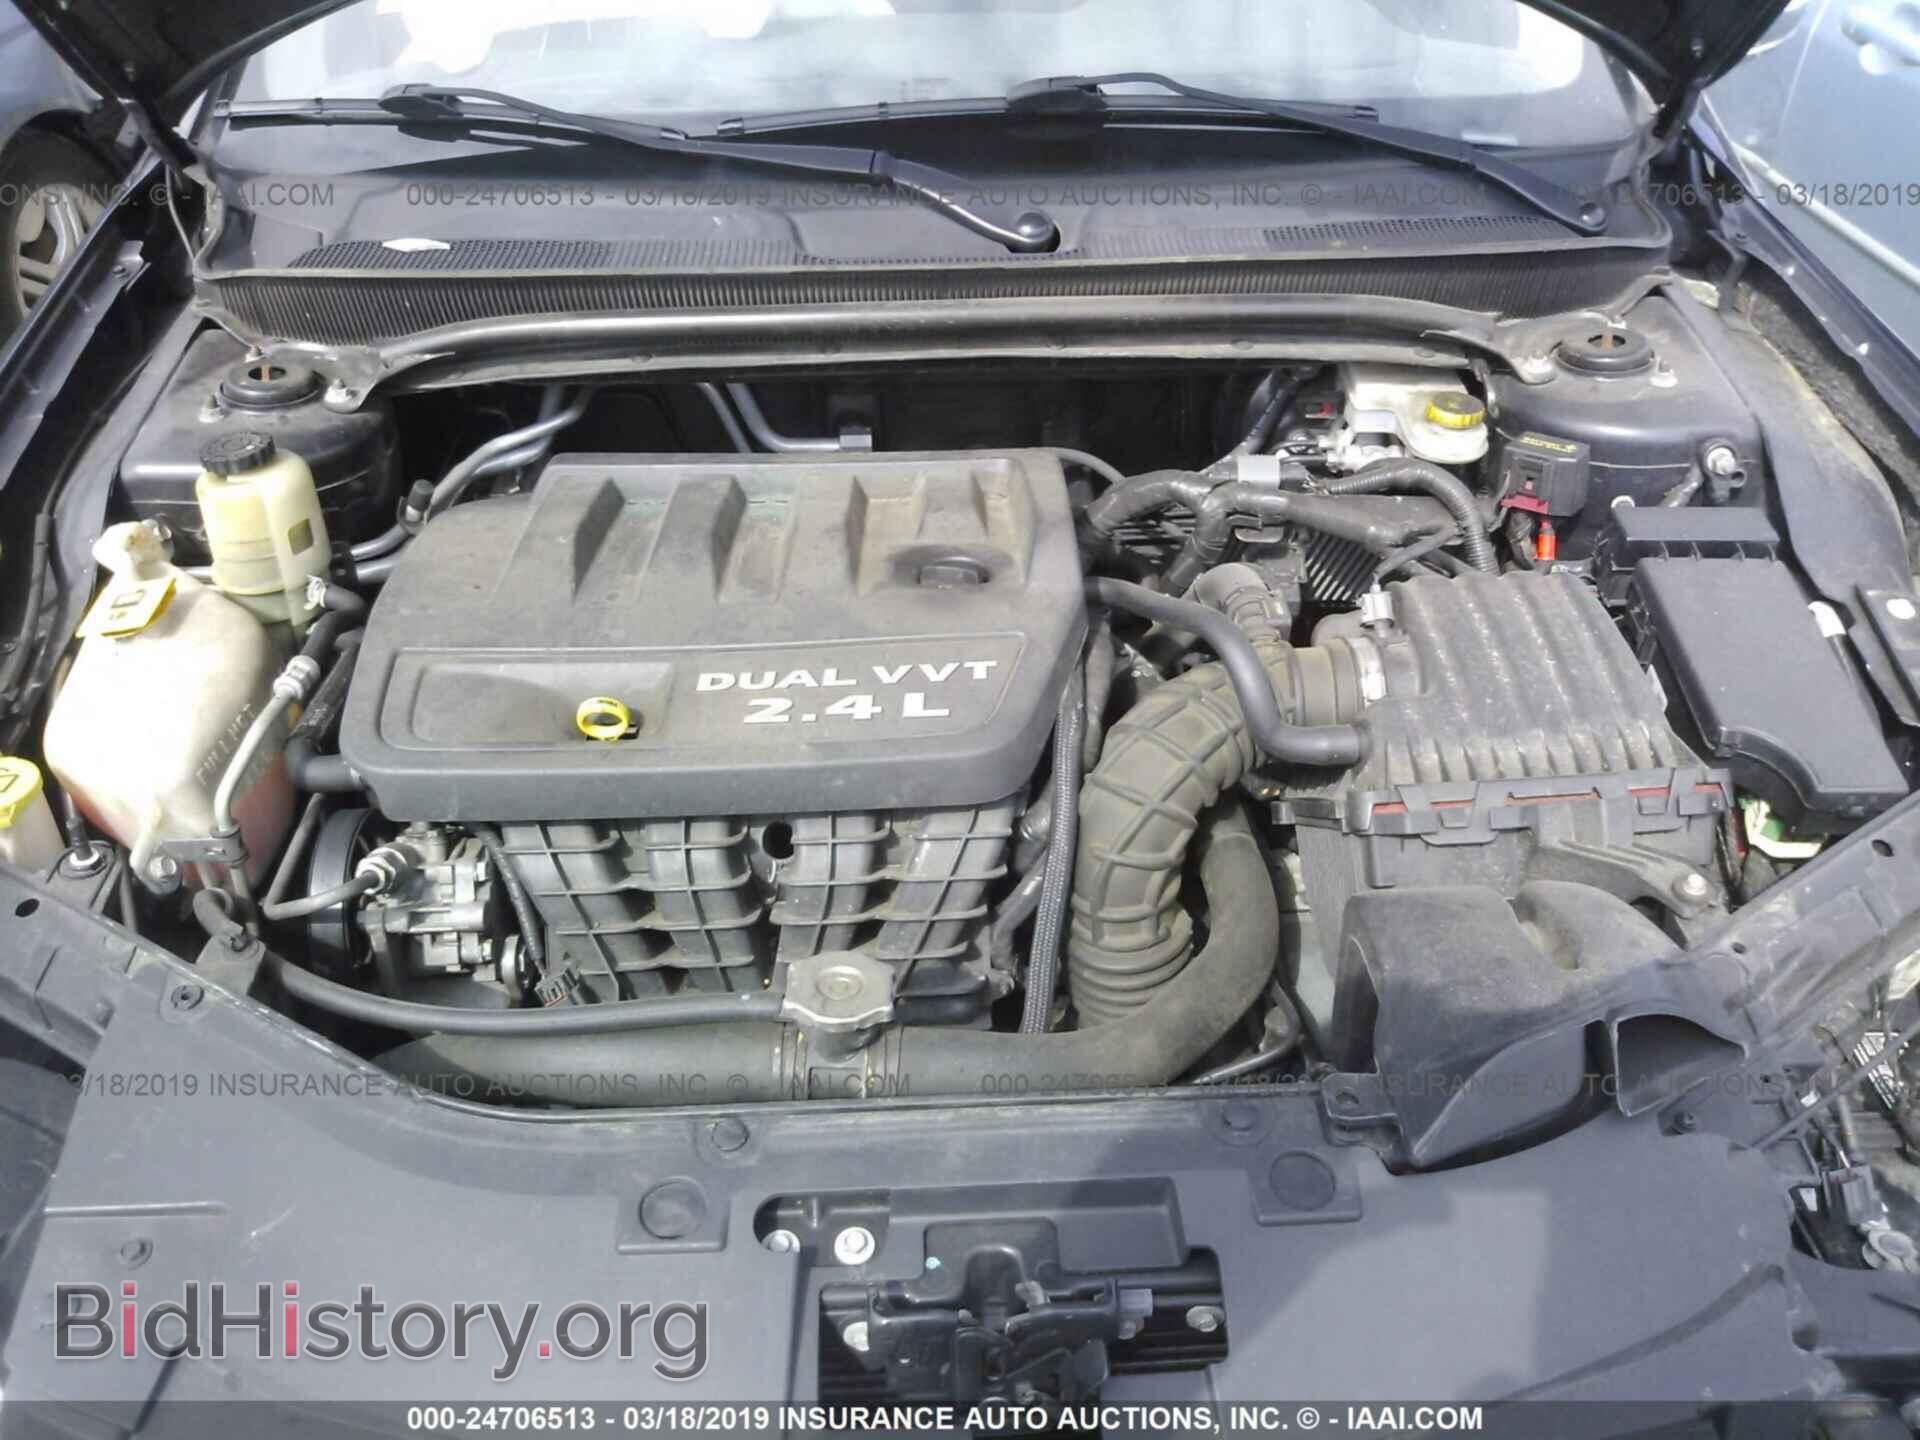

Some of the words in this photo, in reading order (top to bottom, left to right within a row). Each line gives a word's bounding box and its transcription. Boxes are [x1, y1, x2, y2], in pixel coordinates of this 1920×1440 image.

[695, 667, 858, 692] DUAL
[871, 660, 998, 685] VVT
[743, 694, 883, 724] 2.4
[902, 692, 950, 718] L
